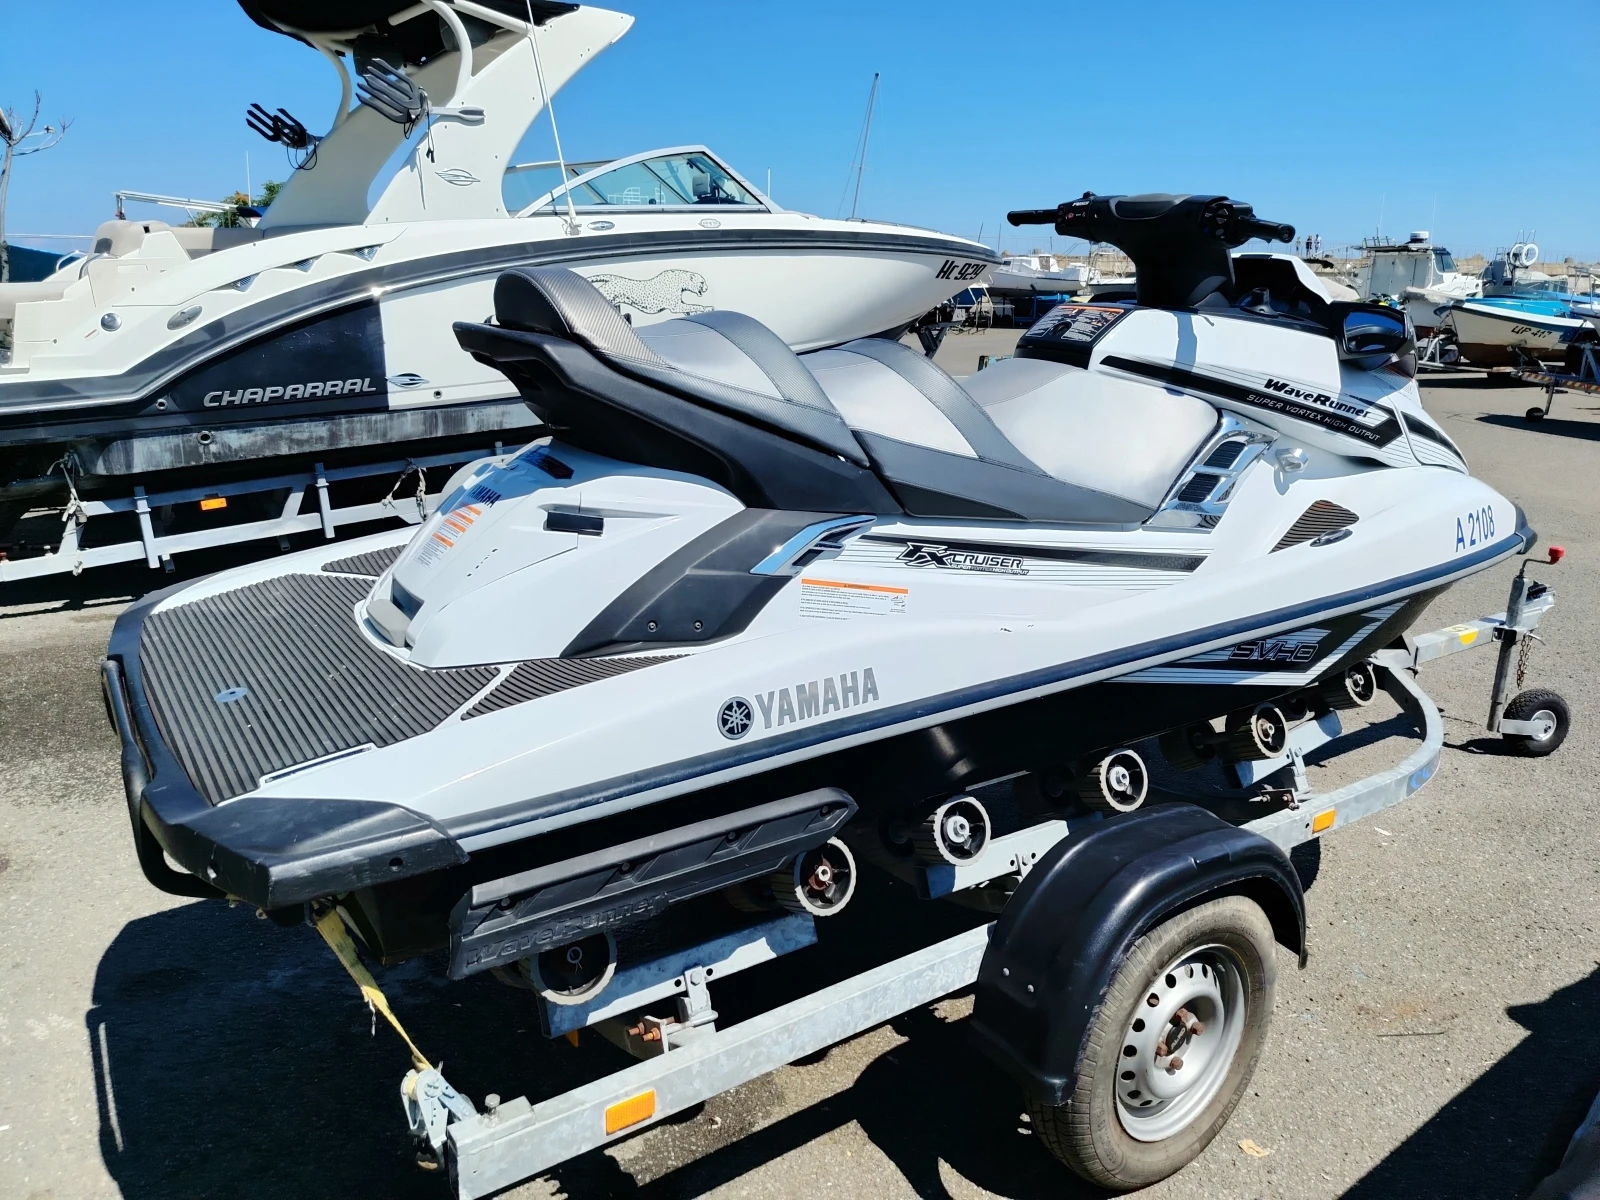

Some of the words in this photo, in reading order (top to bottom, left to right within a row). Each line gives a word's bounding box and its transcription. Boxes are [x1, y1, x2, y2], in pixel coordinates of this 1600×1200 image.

[953, 262, 988, 281] 929
[203, 377, 377, 408] CHAPARRAL
[1263, 378, 1372, 419] WaveRunner
[1246, 394, 1284, 409] SUPER
[1286, 404, 1323, 421] VORTEX
[1323, 416, 1347, 430] HIGH
[1348, 425, 1381, 441] OUTPUT
[1467, 504, 1495, 547] 2108
[950, 552, 1024, 569] CRUISER
[1228, 640, 1319, 662] SVHO
[754, 666, 880, 730] YAMAHA
[465, 894, 662, 968] WaveRunner
